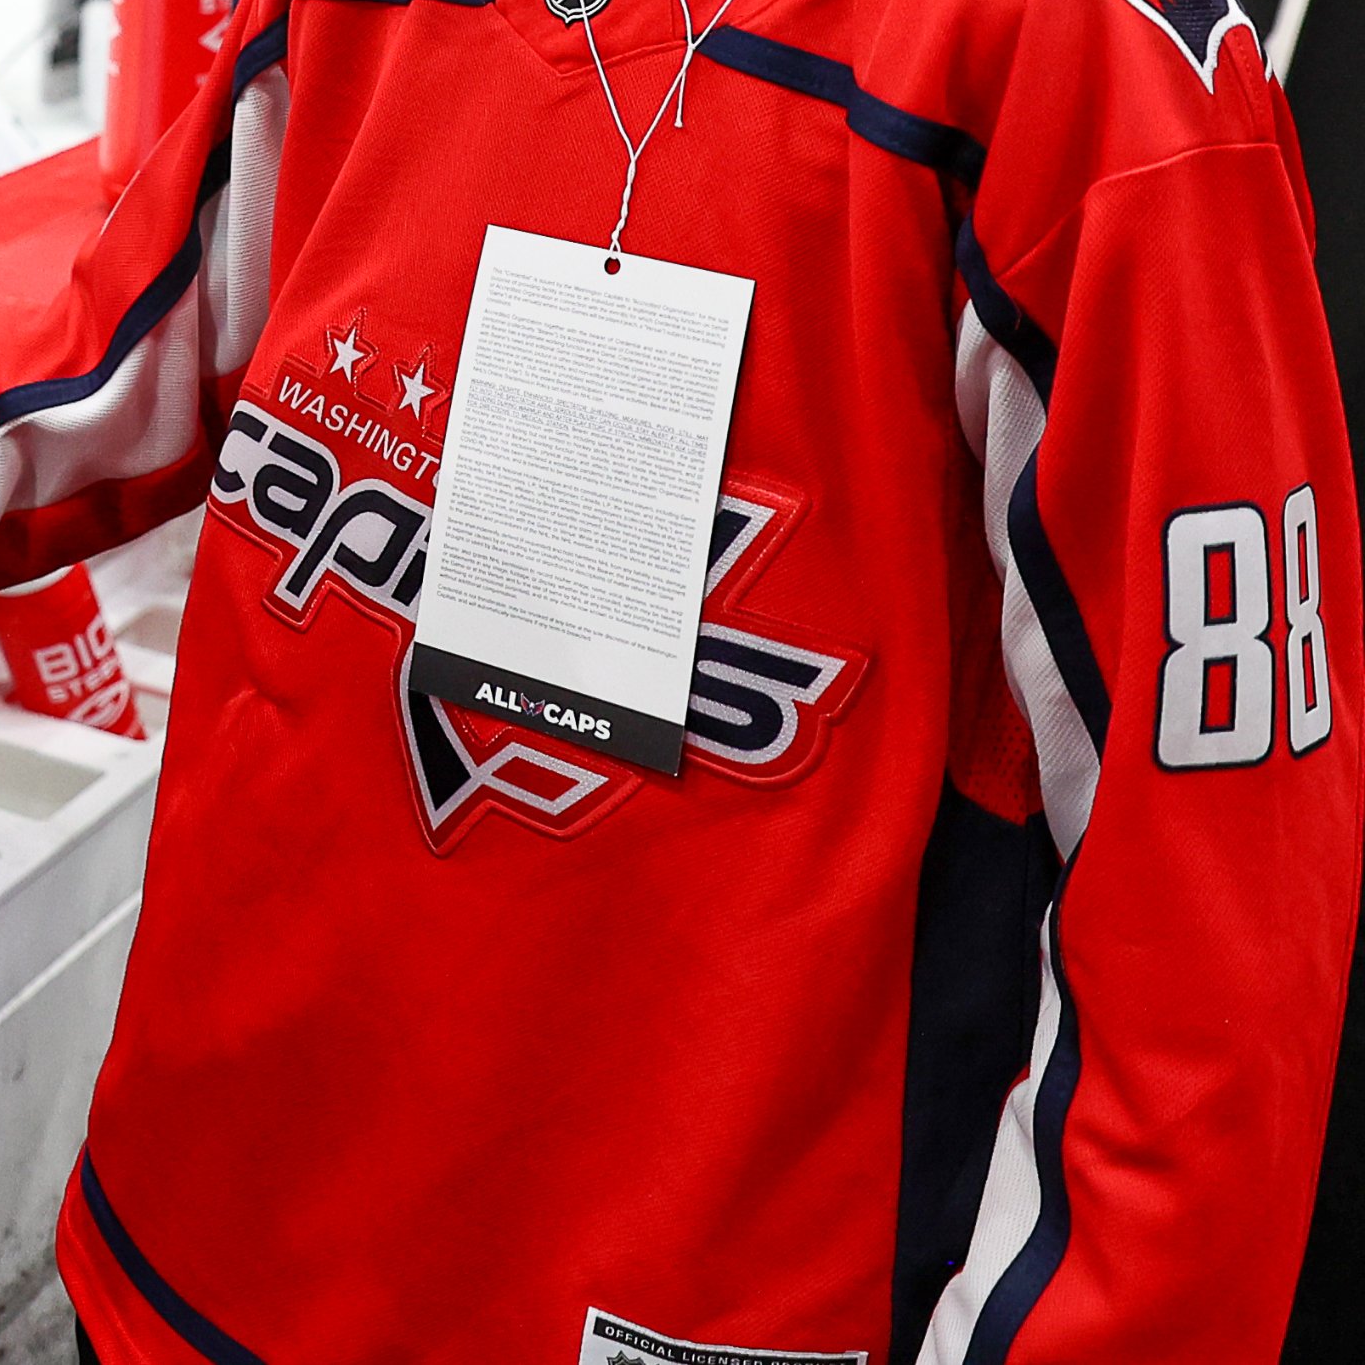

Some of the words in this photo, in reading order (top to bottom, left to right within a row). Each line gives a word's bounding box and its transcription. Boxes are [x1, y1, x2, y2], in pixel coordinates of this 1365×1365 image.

[278, 375, 441, 490] WASHINGT
[34, 613, 115, 683] BIO
[1153, 481, 1333, 773] 88
[475, 682, 522, 714] ALL
[542, 703, 611, 741] CAPS
[603, 1324, 676, 1360] OFFICIAL
